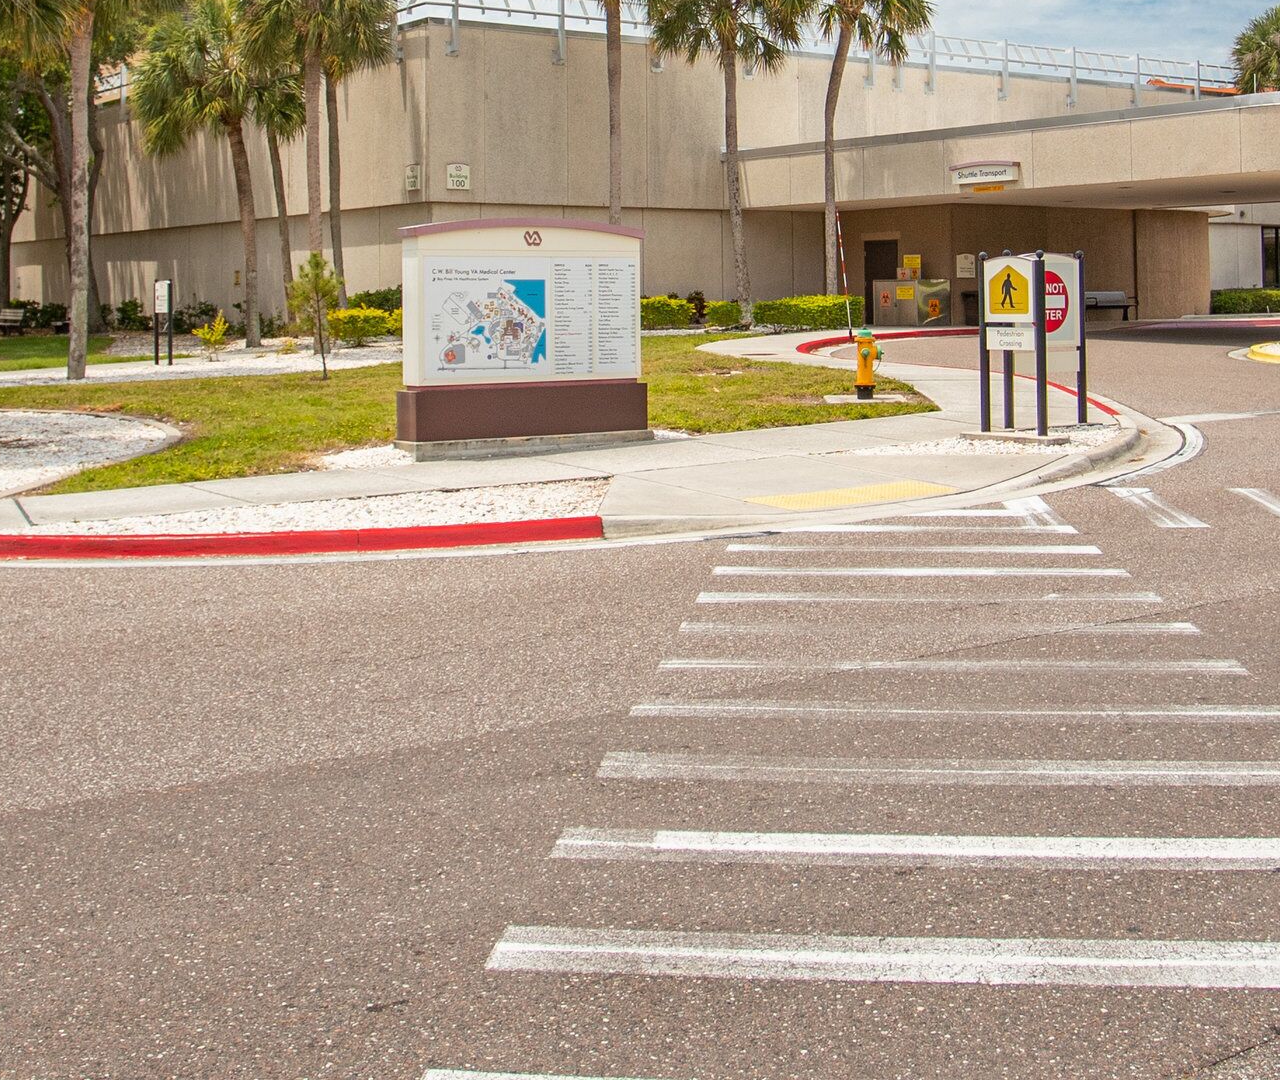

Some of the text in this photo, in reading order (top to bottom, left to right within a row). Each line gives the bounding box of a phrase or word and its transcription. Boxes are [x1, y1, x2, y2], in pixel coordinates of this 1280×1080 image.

[958, 169, 1007, 179] Shuttle Transport
[451, 179, 465, 187] 100
[454, 268, 470, 276] Young
[1045, 283, 1064, 293] NOT
[1045, 310, 1062, 320] TER
